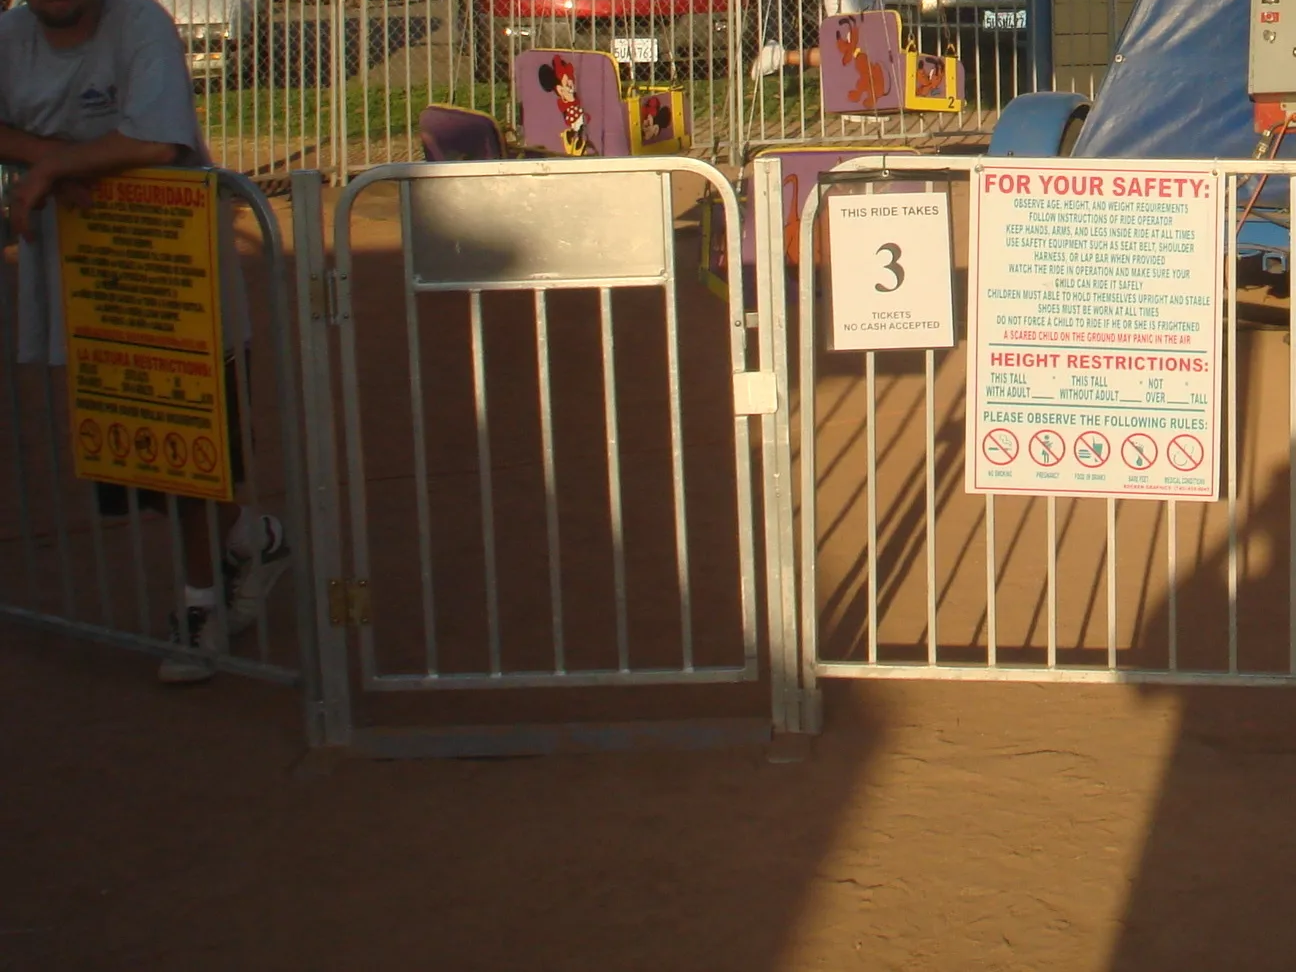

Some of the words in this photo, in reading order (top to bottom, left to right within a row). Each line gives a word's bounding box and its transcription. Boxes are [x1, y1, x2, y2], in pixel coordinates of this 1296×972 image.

[948, 96, 955, 109] 2
[985, 174, 1031, 194] FOR
[1038, 175, 1104, 196] YOUR
[1112, 176, 1209, 198] SAFETY:
[841, 208, 867, 218] THIS
[871, 207, 899, 217] RIDE
[903, 206, 939, 216] TAKES
[1014, 198, 1045, 209] OBSERVE
[1092, 201, 1106, 211] AND
[1108, 201, 1134, 212] WEIGHT
[1136, 202, 1189, 213] REQUIREMENTS
[1029, 212, 1056, 222] FOLLOW
[1058, 213, 1108, 224] INSTRUCTIONS
[1109, 214, 1119, 224] OF
[1120, 215, 1135, 225] RIDE
[1137, 216, 1173, 226] OPERATOR
[1006, 224, 1023, 234] KEEP
[1074, 227, 1089, 236] AND
[1090, 227, 1108, 236] LEGS
[1109, 228, 1132, 238] INSIDE
[1133, 229, 1149, 238] RIDE
[1151, 229, 1159, 239] AT
[1161, 230, 1173, 239] ALL
[1175, 230, 1195, 240] TIMES
[1006, 237, 1019, 247] USE
[1021, 238, 1047, 248] SAFETY
[1048, 239, 1087, 249] EQUIPMENT
[1090, 240, 1108, 250] SUCH
[1110, 241, 1118, 250] AS
[1120, 241, 1137, 251] SEAT
[1159, 242, 1194, 253] SHOULDER
[1069, 252, 1079, 262] OR
[1081, 253, 1094, 262] LAP
[1095, 253, 1109, 263] BAR
[1110, 254, 1131, 264] WHEN
[1132, 255, 1166, 265] PROVIDED
[874, 242, 905, 292] 3
[1009, 264, 1032, 274] WATCH
[1034, 264, 1047, 274] THE
[1049, 265, 1064, 275] RIDE
[1067, 265, 1074, 275] IN
[1075, 266, 1114, 277] OPERATION
[1115, 267, 1130, 277] AND
[1131, 268, 1151, 278] MAKE
[1152, 268, 1170, 278] SURE
[1172, 269, 1190, 279] YOUR
[1055, 278, 1075, 288] CHILD
[1077, 279, 1091, 288] CAN
[1092, 279, 1108, 289] RIDE
[1110, 280, 1117, 289] IT
[1118, 280, 1143, 291] SAFELY
[987, 288, 1021, 299] CHILDREN
[1023, 290, 1041, 300] MUST
[1043, 290, 1060, 301] ABLE
[1062, 291, 1071, 301] TO
[1073, 292, 1091, 301] HOLD
[1093, 292, 1136, 303] THEMSELVES
[1138, 294, 1169, 304] UPRIGHT
[1170, 295, 1184, 305] AND
[1185, 296, 1210, 306] STABLE
[872, 311, 911, 320] TICKETS
[1038, 304, 1060, 314] SHOES
[1062, 304, 1080, 314] MUST
[1082, 306, 1091, 315] BE
[1093, 306, 1113, 315] WORN
[1115, 307, 1124, 316] AT
[1126, 307, 1137, 316] ALL
[1139, 307, 1159, 317] TIMES
[844, 323, 858, 332] NO
[860, 322, 887, 331] CASH
[889, 321, 940, 330] ACCEPTED
[997, 315, 1006, 324] DO
[1008, 316, 1022, 325] NOT
[1023, 316, 1045, 326] FORCE
[1047, 317, 1052, 326] A
[1053, 317, 1073, 327] CHILD
[1075, 318, 1085, 328] TO
[1086, 318, 1101, 328] RIDE
[1104, 319, 1110, 328] IF
[1112, 319, 1121, 329] HE
[1122, 320, 1132, 329] OR
[1134, 320, 1147, 330] SHE
[1149, 321, 1156, 330] IS
[1157, 321, 1200, 331] FRIGHTENED
[1004, 330, 1008, 340] A
[1010, 330, 1036, 341] SCARED
[1039, 331, 1058, 341] CHILD
[1060, 332, 1070, 341] ON
[1072, 332, 1085, 342] THE
[1087, 332, 1116, 343] GROUND
[1117, 333, 1132, 343] MAY
[1133, 334, 1153, 344] PANIC
[1155, 335, 1162, 344] IN
[1164, 335, 1177, 344] THE
[1179, 335, 1191, 345] AIR
[991, 352, 1061, 368] HEIGHT
[1067, 354, 1209, 372] RESTRICTIONS:
[991, 372, 1007, 384] THIS
[1010, 373, 1027, 384] TALL
[1071, 375, 1089, 387] THIS
[1091, 376, 1108, 387] TALL
[1148, 378, 1163, 389] NOT
[986, 386, 1005, 397] WITH
[1007, 387, 1031, 398] ADULT
[1060, 388, 1093, 400] WITHOUT
[1095, 390, 1119, 401] ADULT
[1145, 392, 1166, 403] OVER
[1190, 393, 1208, 404] TALL
[983, 411, 1024, 423] PLEASE
[1027, 412, 1076, 425] OBSERVE
[1080, 414, 1101, 426] THE
[1104, 415, 1166, 428] FOLLOWING
[1170, 417, 1208, 430] RULES:
